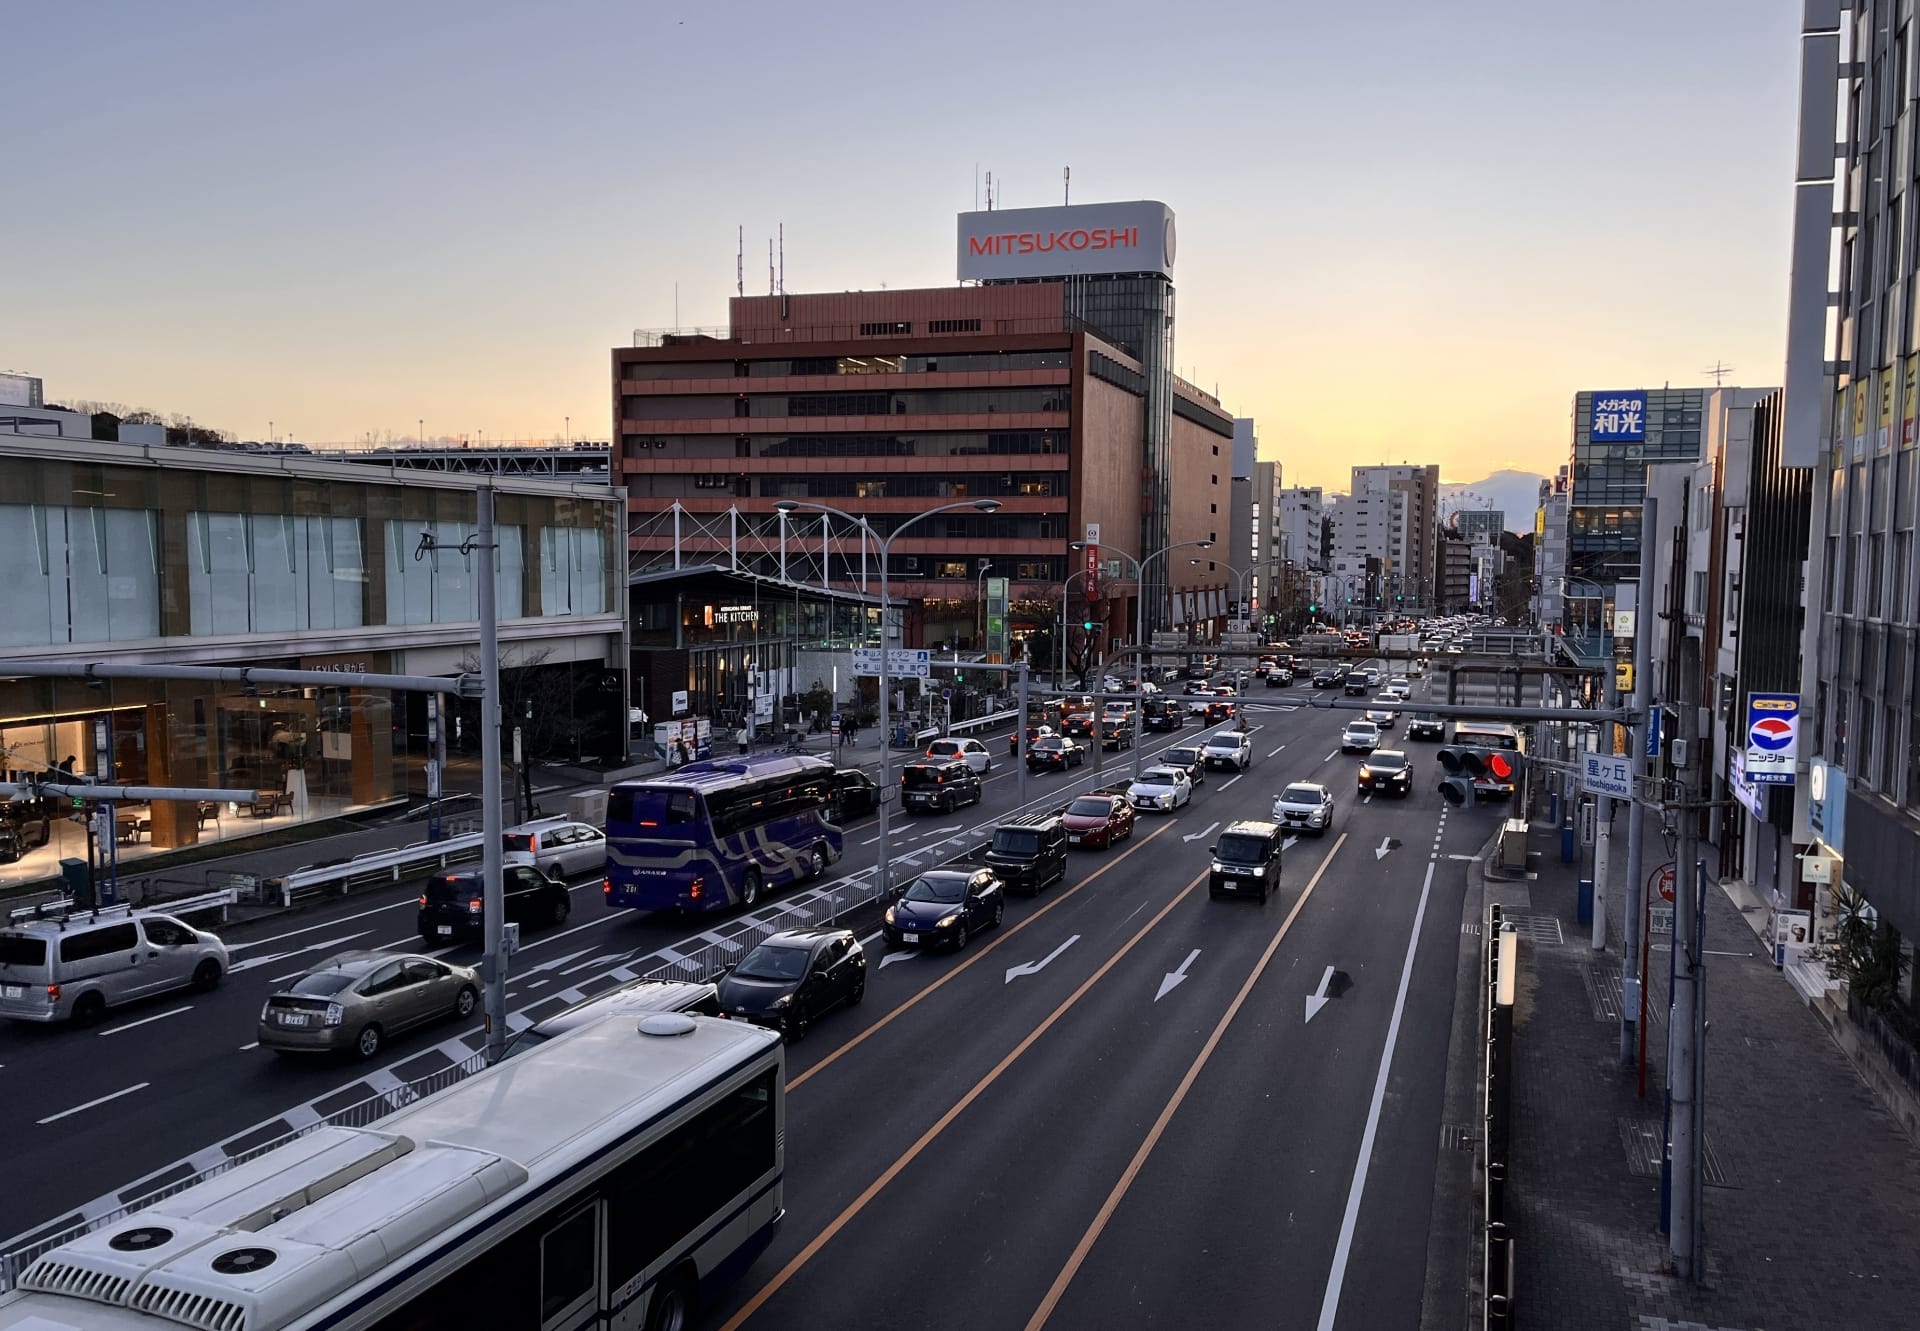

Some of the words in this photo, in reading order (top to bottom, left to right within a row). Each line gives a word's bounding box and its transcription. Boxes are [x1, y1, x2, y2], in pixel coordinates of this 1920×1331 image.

[969, 226, 1139, 257] MITSUKOSHI
[1596, 399, 1642, 412] メガネの
[1593, 413, 1643, 434] 和光
[714, 612, 728, 624] THE
[730, 610, 759, 623] KITCHEN
[862, 649, 917, 658] 東山スイタワー
[1748, 752, 1795, 764] ニッショー
[1586, 777, 1627, 793] Hoshigaoka
